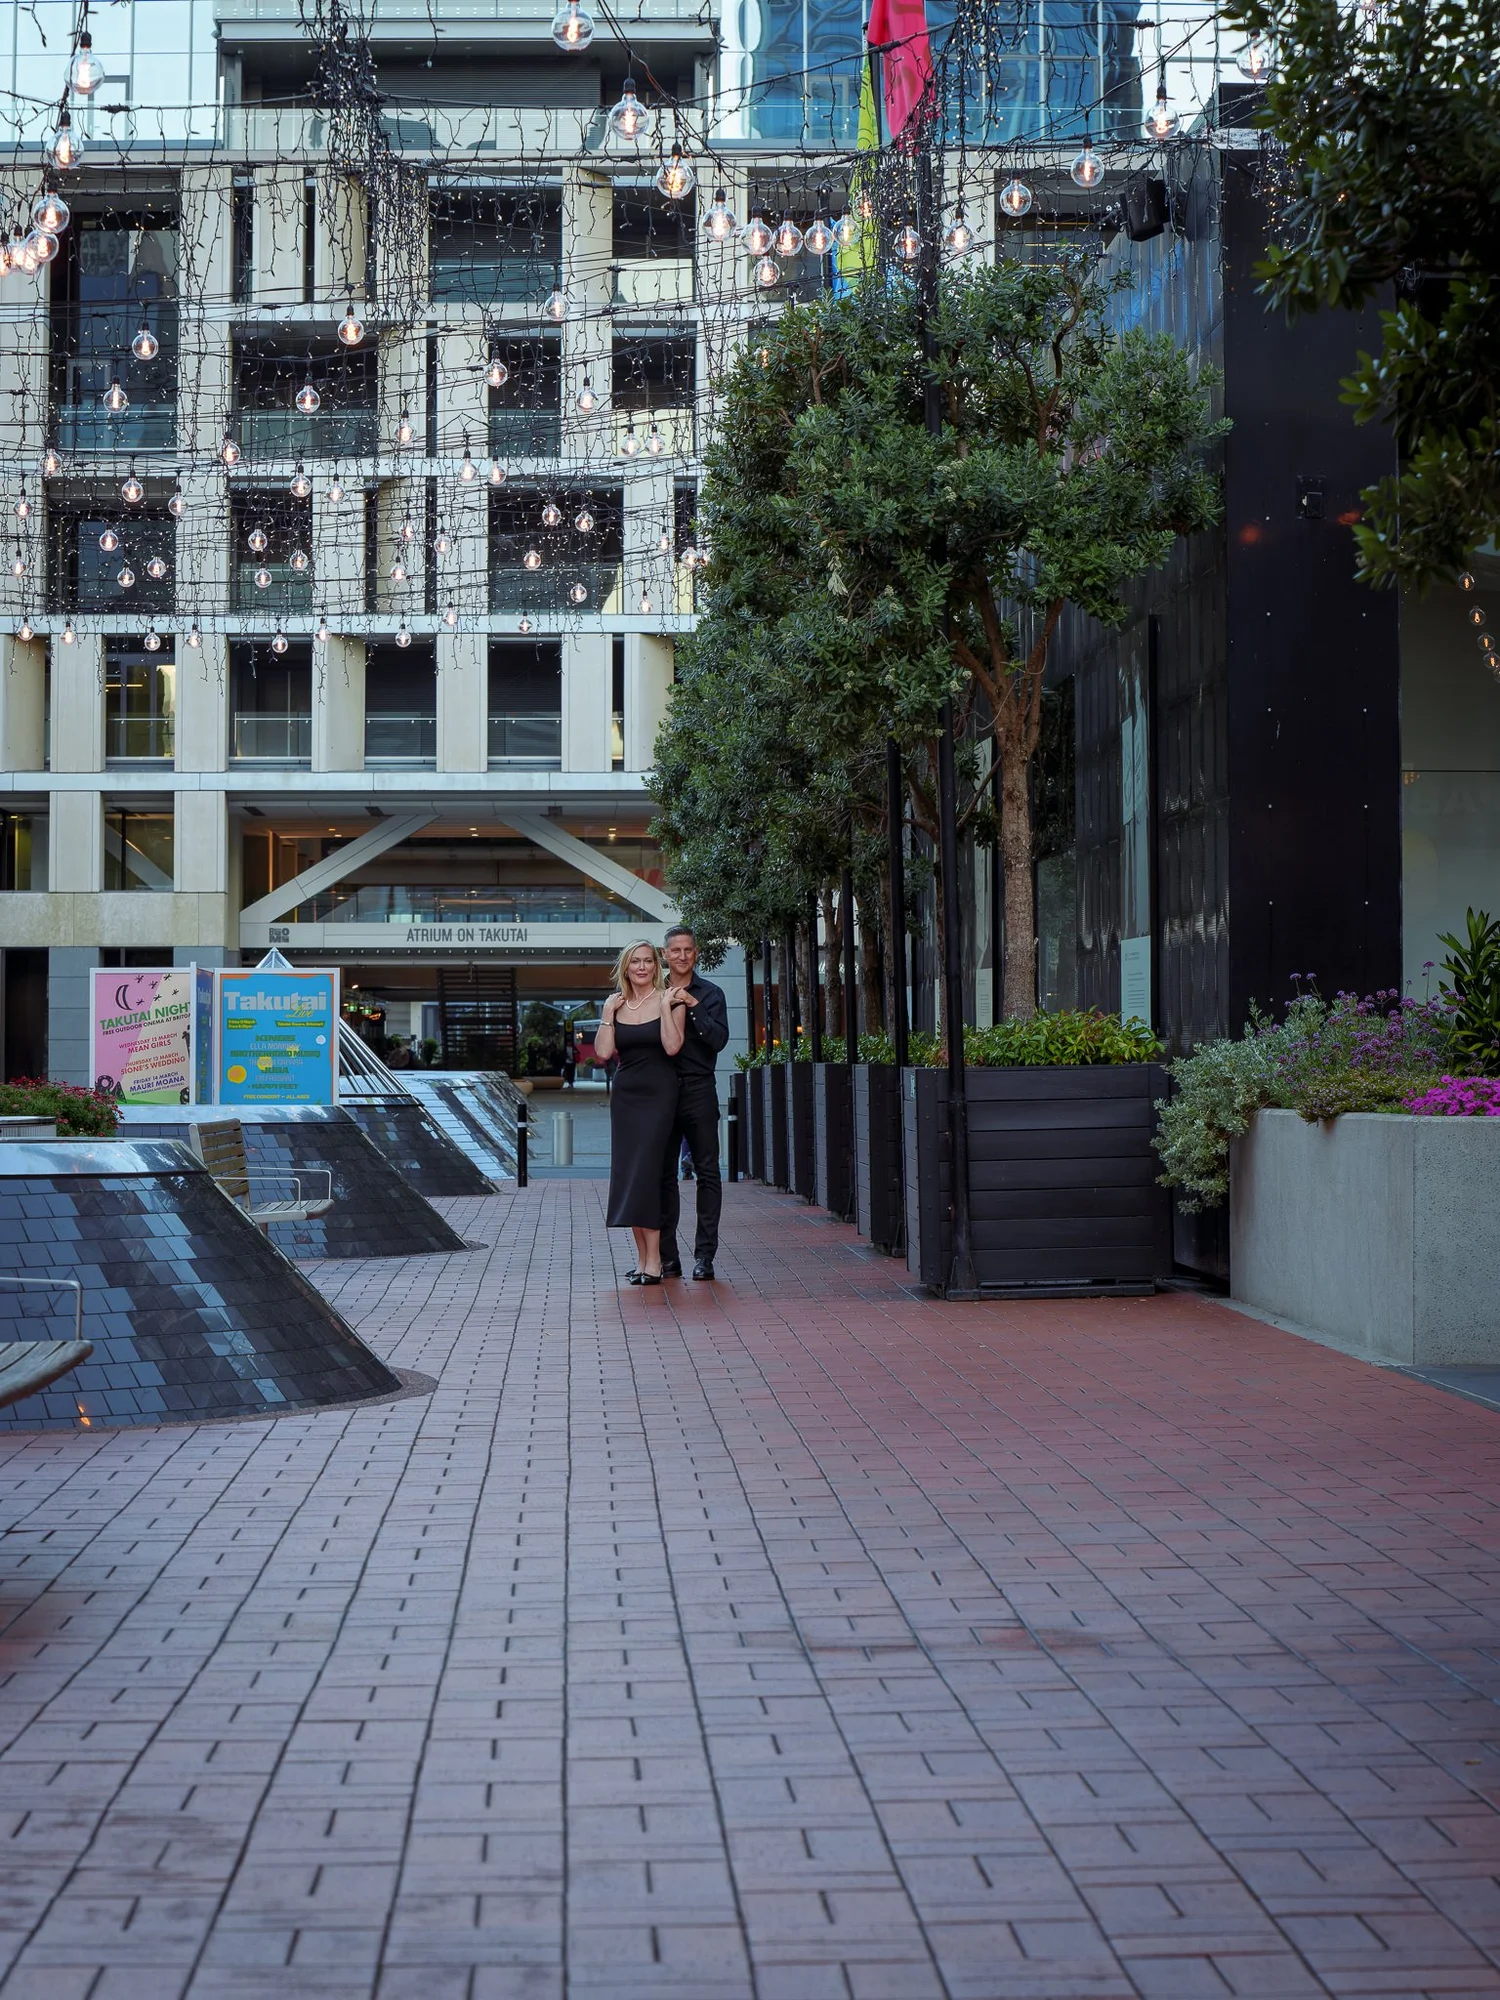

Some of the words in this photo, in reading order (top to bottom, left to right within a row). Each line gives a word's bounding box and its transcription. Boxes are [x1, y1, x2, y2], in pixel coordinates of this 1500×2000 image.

[406, 928, 452, 942] ATRIUM
[457, 928, 474, 942] ON
[478, 928, 528, 942] TAKUTAI
[224, 991, 327, 1011] Takutai
[100, 1010, 151, 1030] TAKUTAI
[154, 1002, 191, 1018] NIGH
[115, 1024, 143, 1033] OUTDOOR
[143, 1019, 164, 1027] CINEMA
[118, 1038, 151, 1049] WEDNESDAY
[158, 1032, 178, 1041] MARCH
[127, 1044, 150, 1054] MEAN
[150, 1039, 172, 1049] GIRLS
[125, 1057, 152, 1067] THURSDAY
[159, 1052, 179, 1060] MARCH
[150, 1056, 186, 1069] WEDDING
[129, 1082, 154, 1092] MAURI
[155, 1075, 185, 1087] MOANA
[133, 1077, 151, 1085] FRIDAY
[158, 1071, 179, 1079] MARCH
